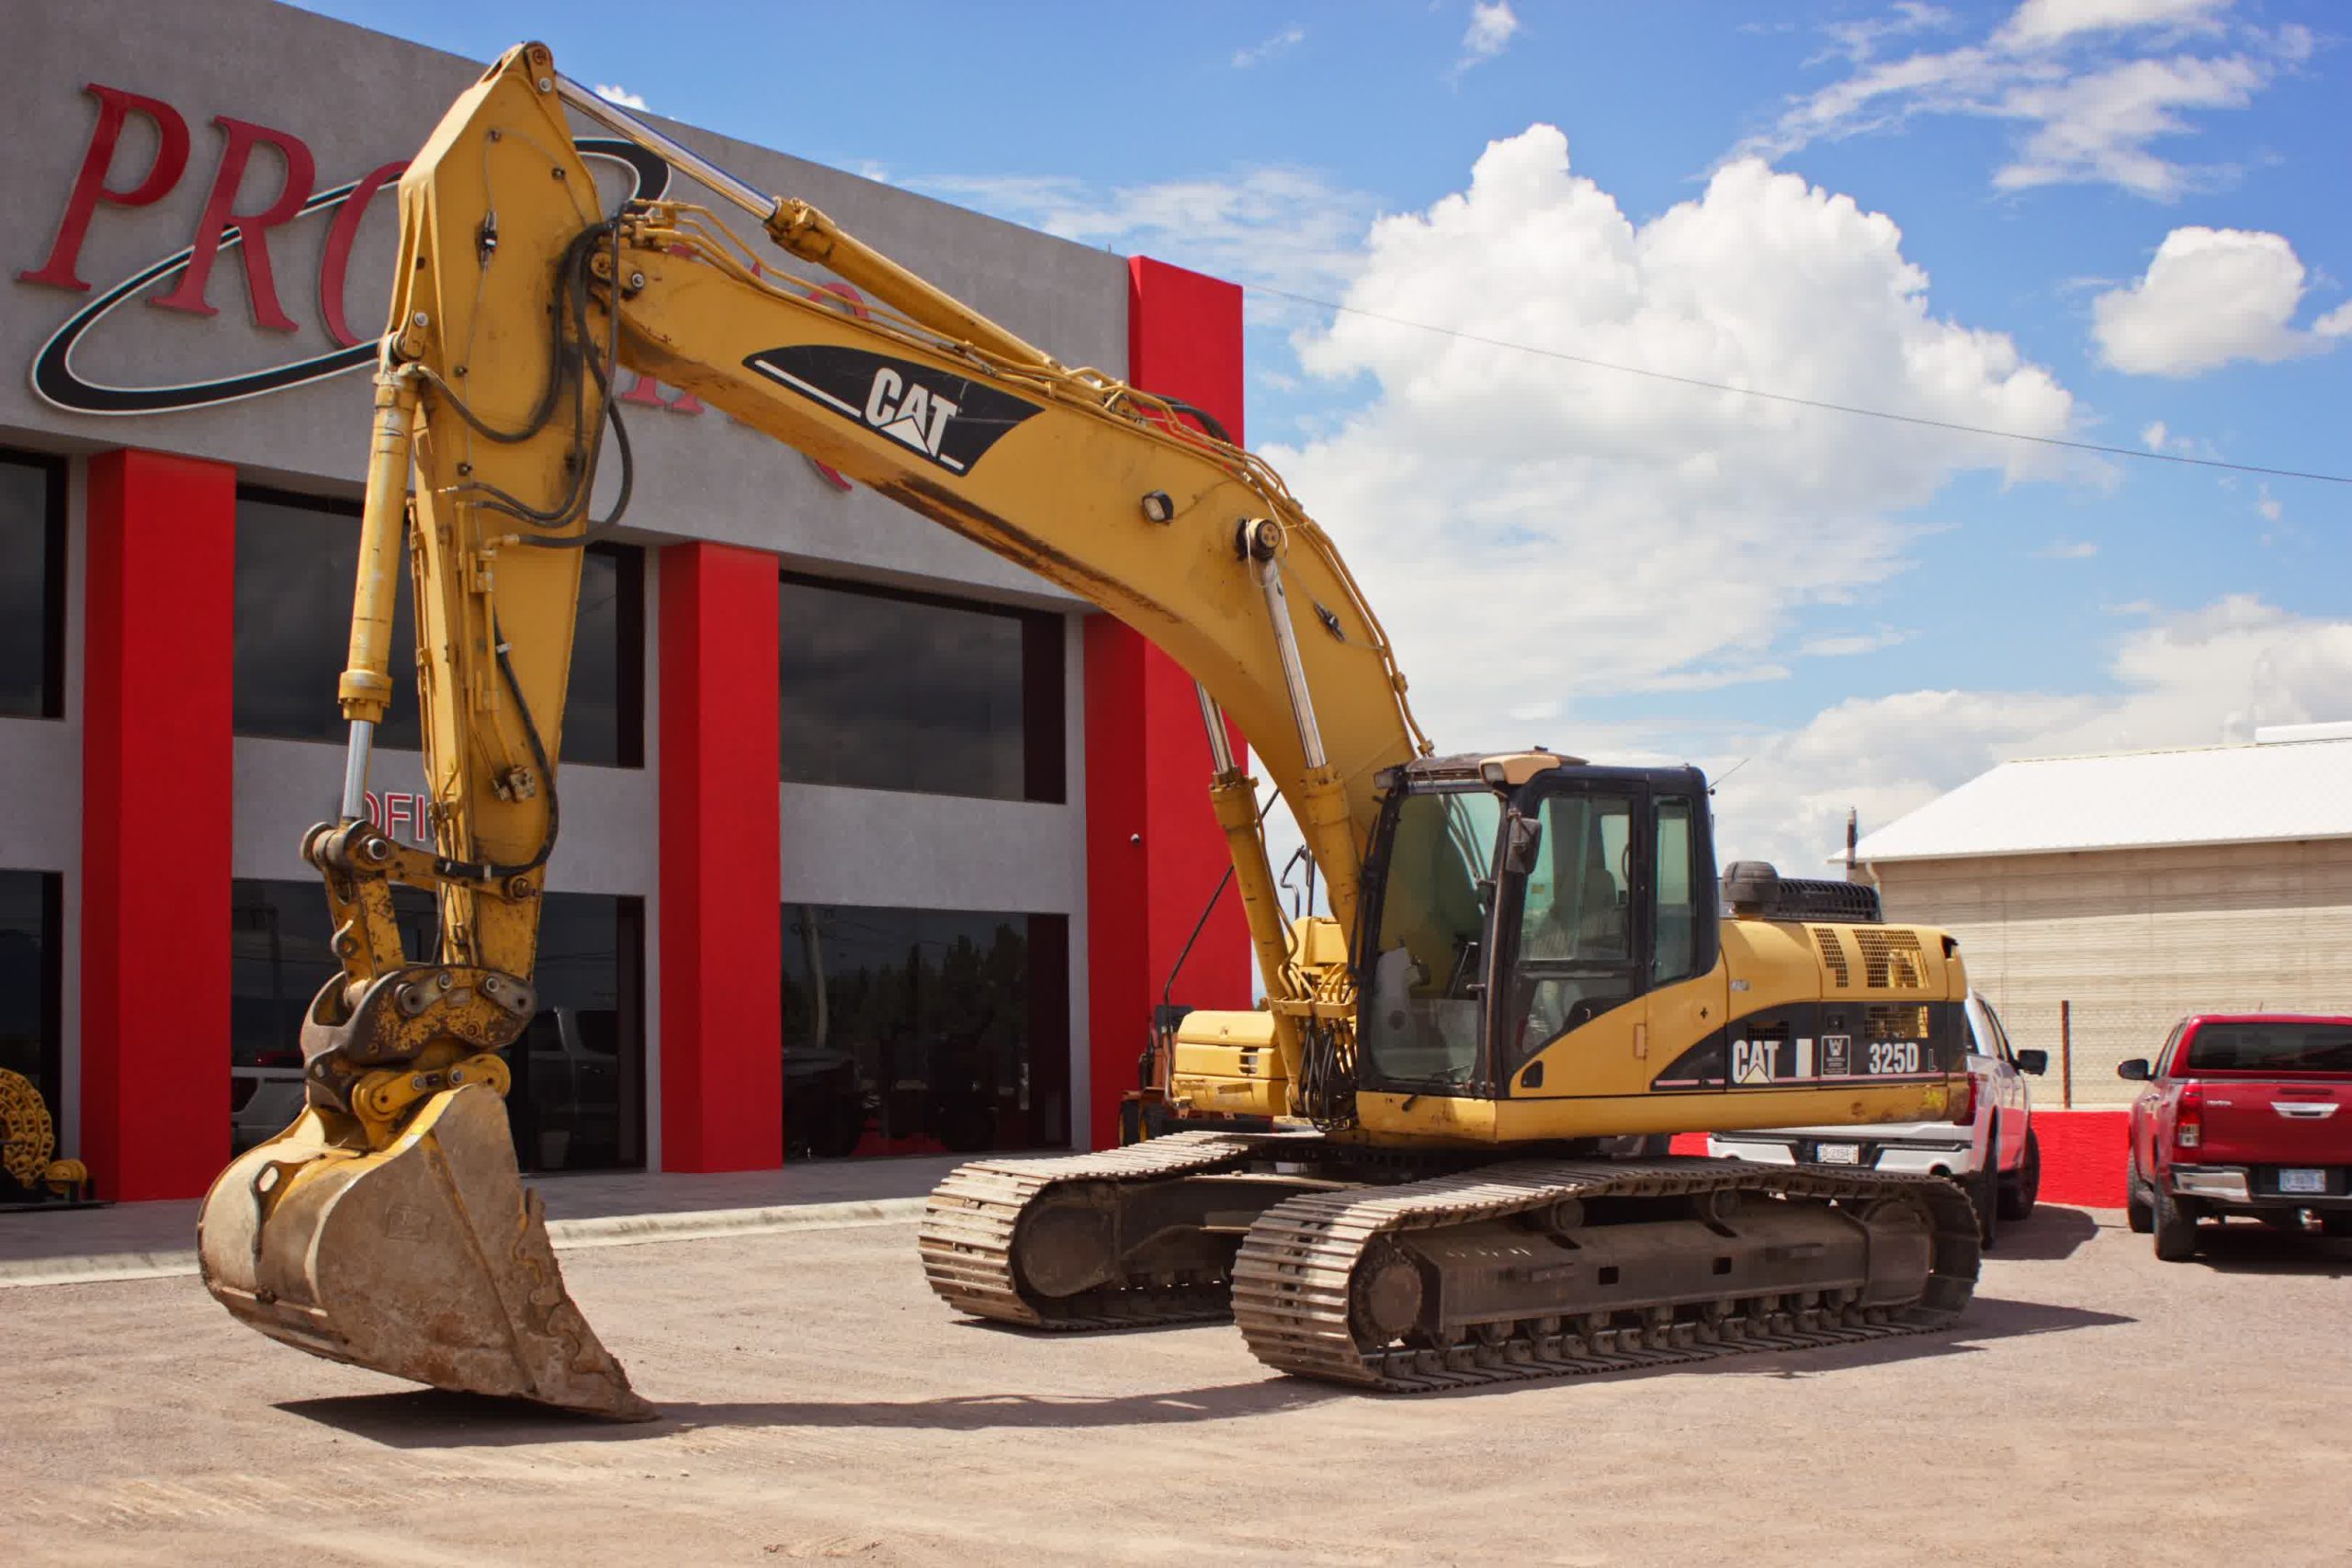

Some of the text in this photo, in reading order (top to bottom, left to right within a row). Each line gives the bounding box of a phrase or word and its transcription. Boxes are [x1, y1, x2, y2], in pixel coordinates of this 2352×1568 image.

[865, 367, 958, 459] CAT
[1732, 1039, 1782, 1084] CAT
[1869, 1042, 1919, 1074] 325D
